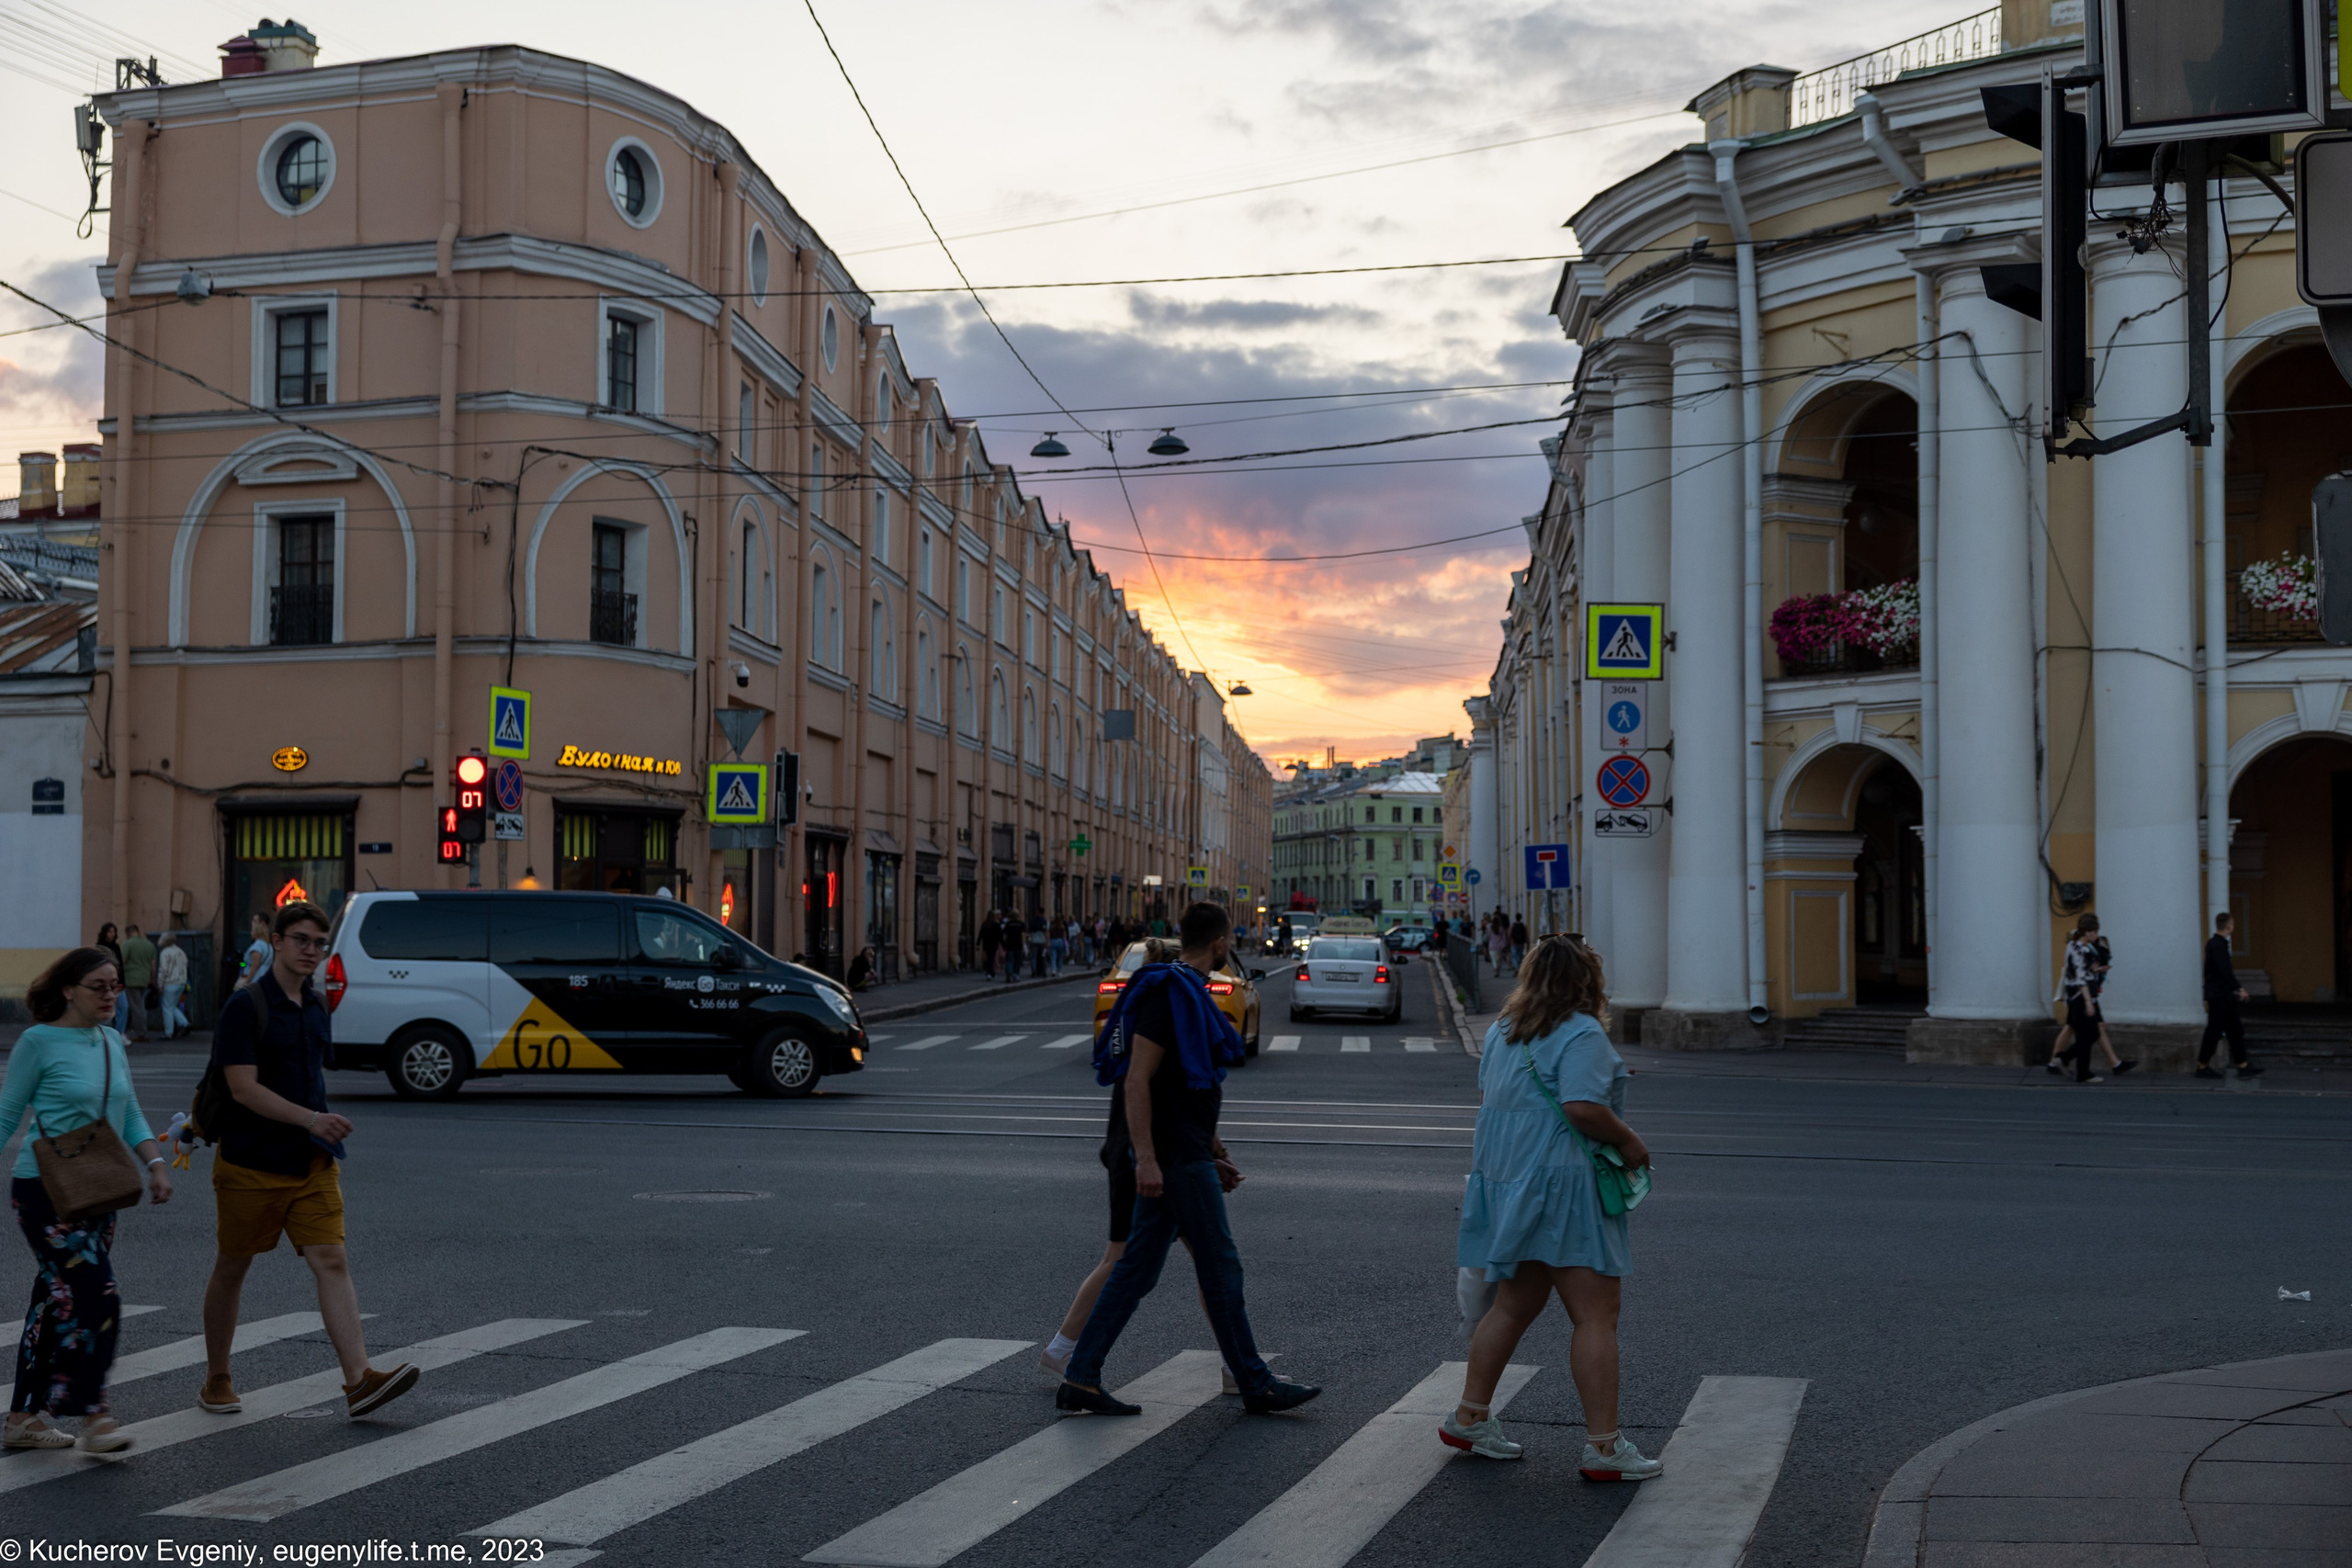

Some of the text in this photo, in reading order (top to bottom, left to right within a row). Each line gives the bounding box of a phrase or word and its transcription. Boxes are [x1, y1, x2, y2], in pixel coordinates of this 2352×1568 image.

[1611, 685, 1637, 694] ЗОНА
[461, 790, 483, 808] 07
[443, 841, 461, 859] 07
[569, 975, 589, 987] 185
[664, 976, 695, 989] Яндекс
[700, 977, 712, 989] Go
[716, 978, 740, 990] Такси
[700, 998, 739, 1009] 366 66 66
[514, 1019, 571, 1069] Go
